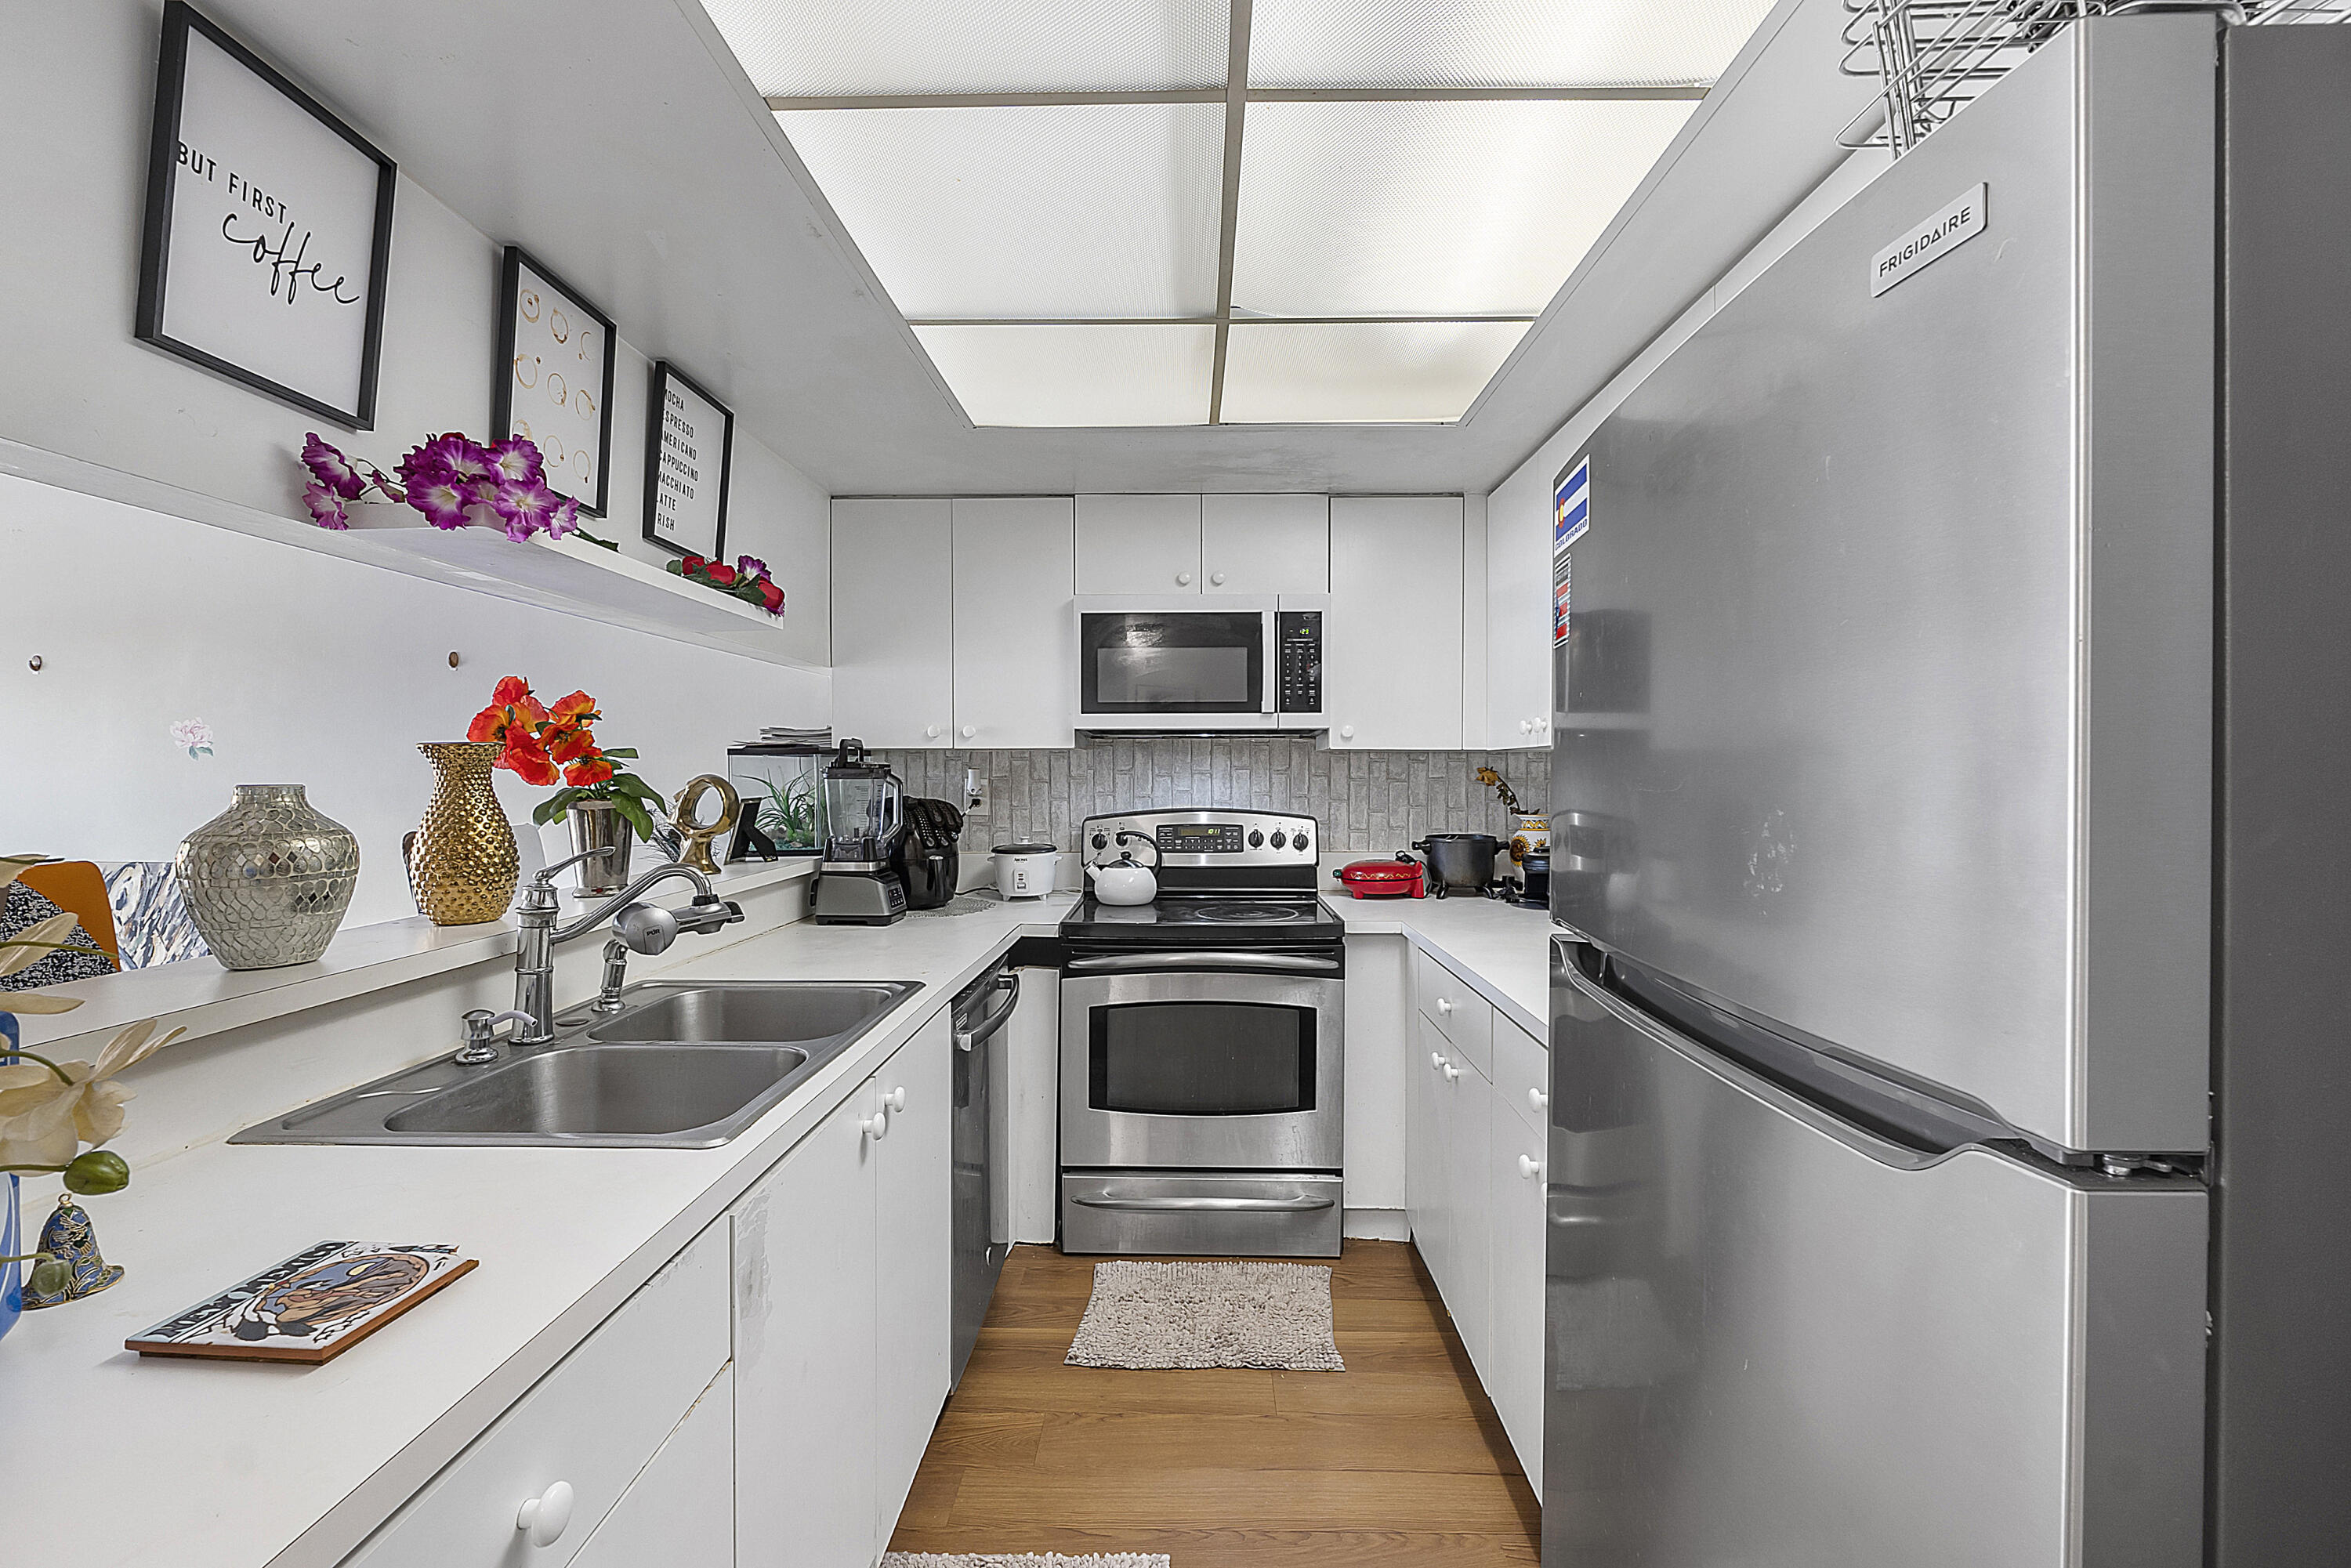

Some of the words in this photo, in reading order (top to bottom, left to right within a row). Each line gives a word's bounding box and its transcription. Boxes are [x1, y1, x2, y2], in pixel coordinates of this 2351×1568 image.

[176, 140, 216, 182] BUT
[229, 172, 288, 224] FIRST
[223, 213, 360, 305] coffee
[1879, 206, 1971, 278] FRIGIDAIRE
[661, 429, 697, 461] MERICANO
[662, 408, 694, 439] SPRESSO
[657, 492, 676, 511] ATTE
[1555, 517, 1588, 552] COLORADO
[143, 1293, 249, 1338] NEW
[229, 1242, 347, 1294] MEXICO
